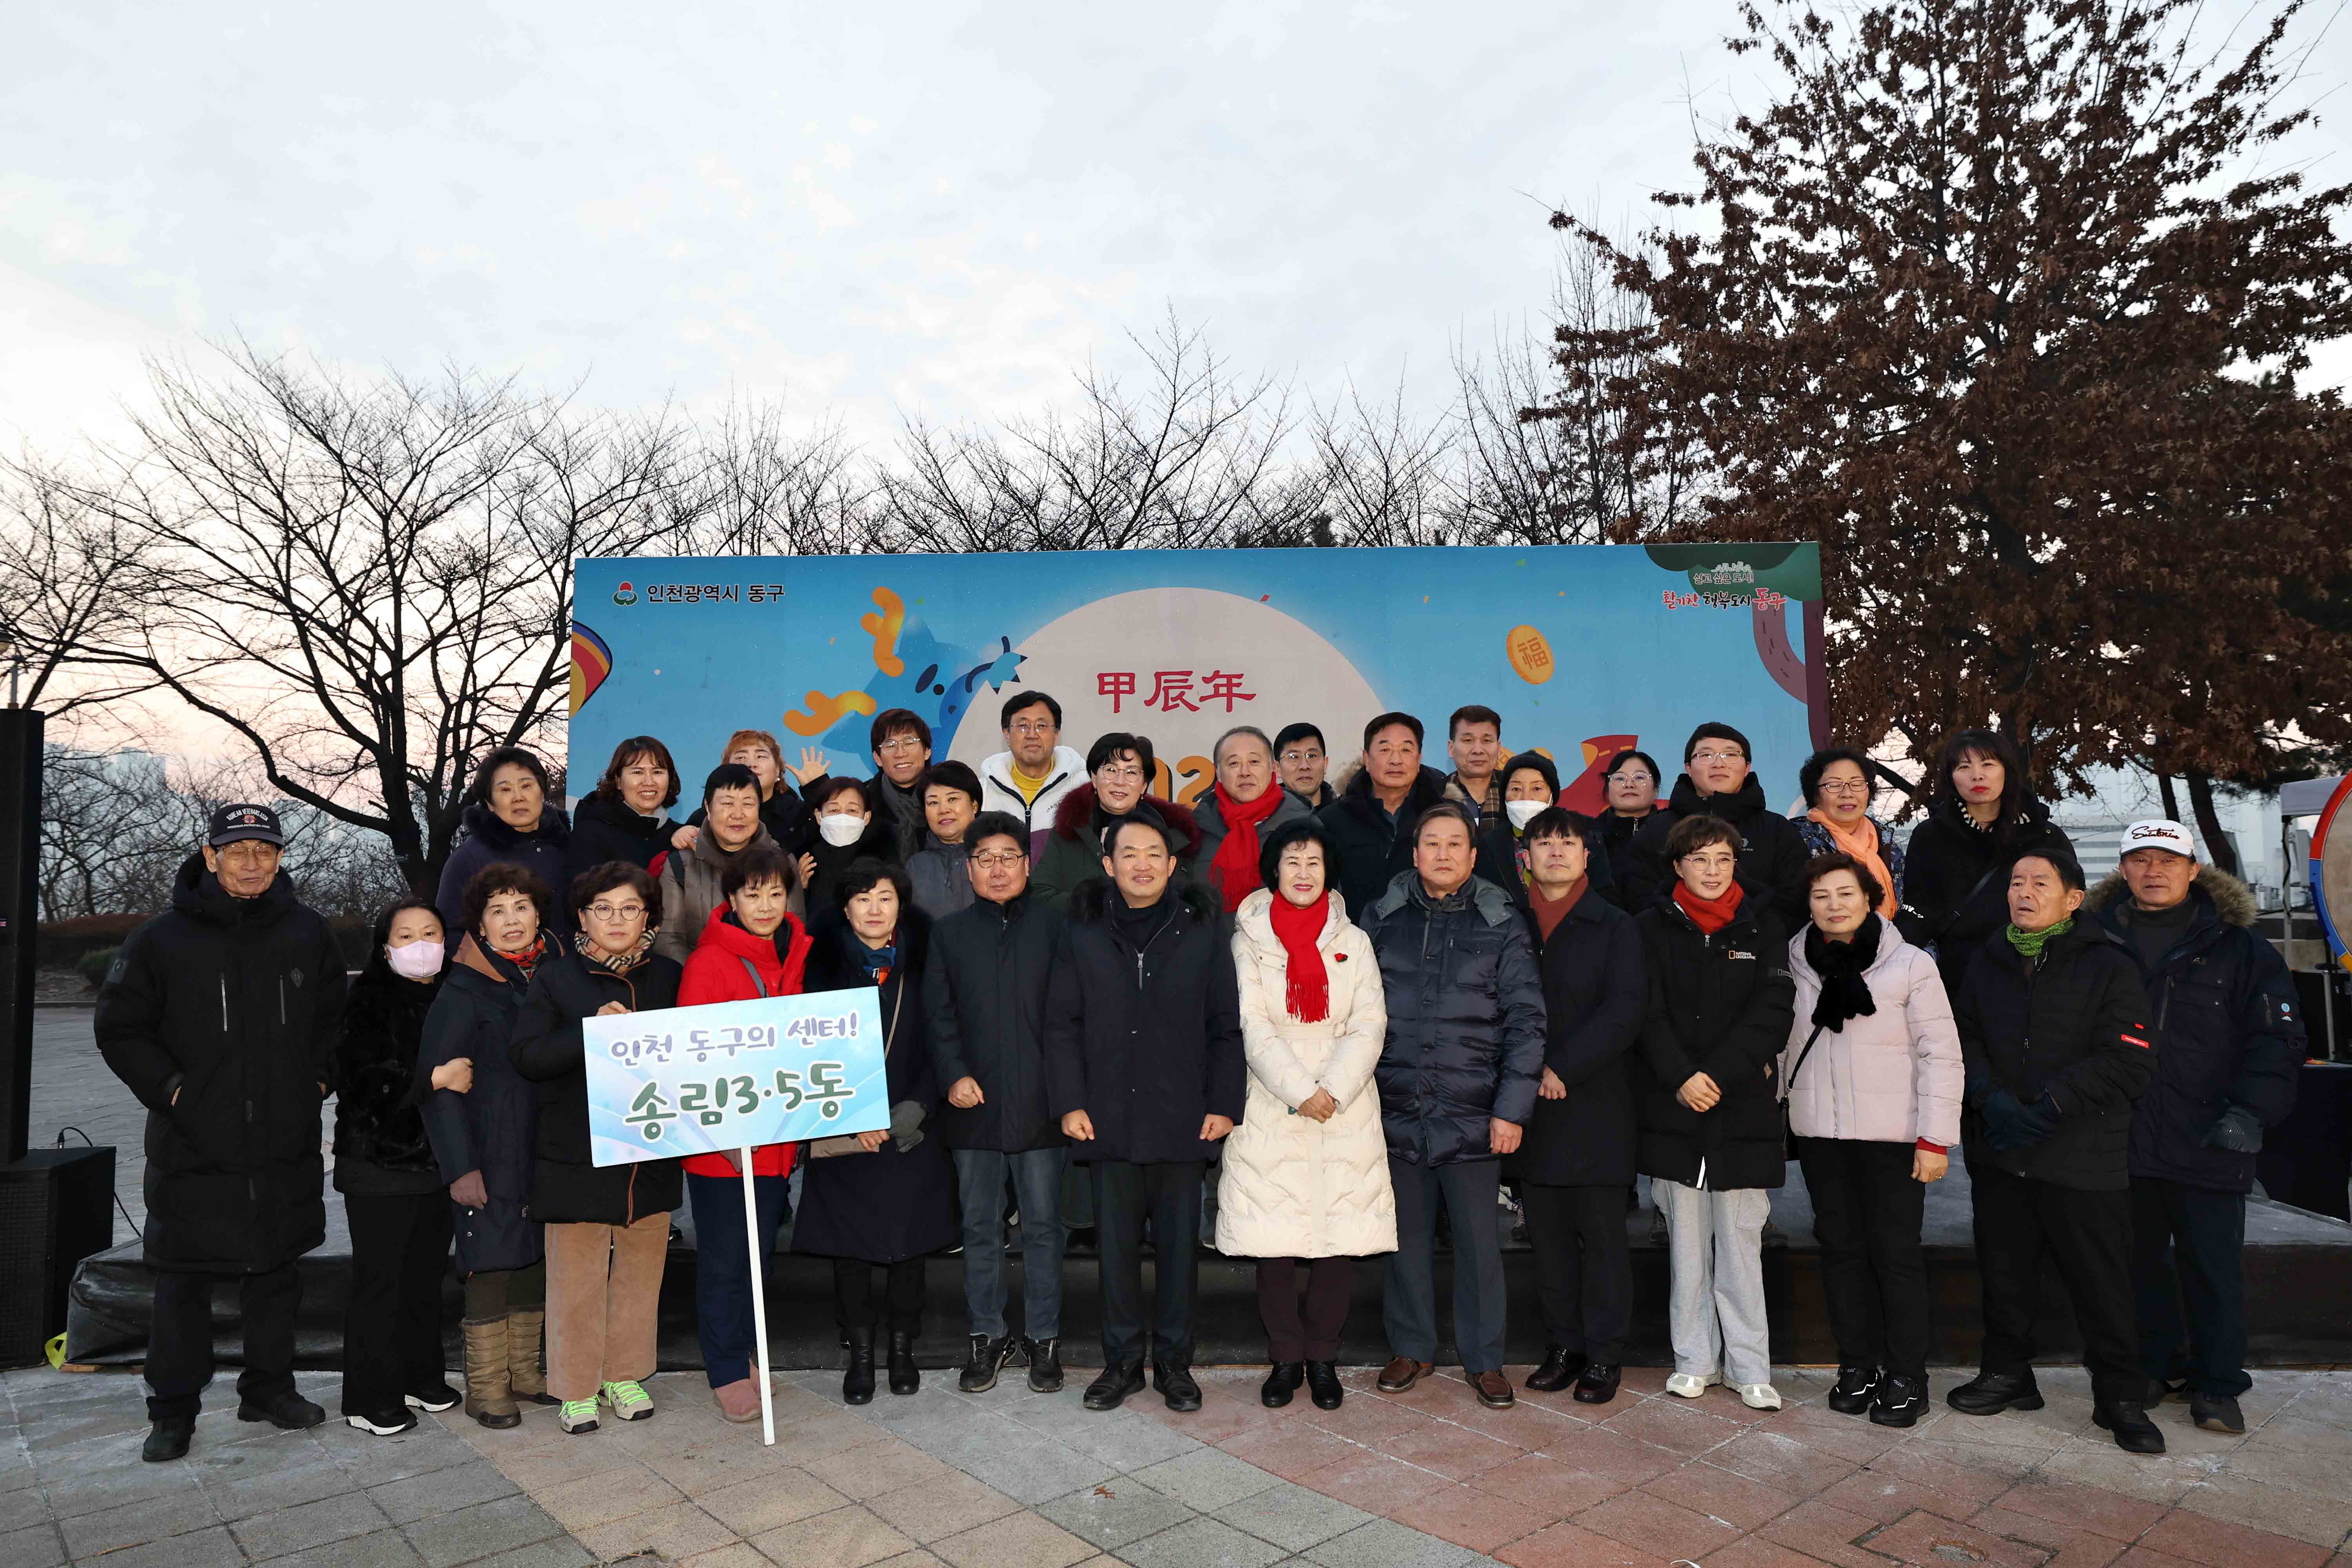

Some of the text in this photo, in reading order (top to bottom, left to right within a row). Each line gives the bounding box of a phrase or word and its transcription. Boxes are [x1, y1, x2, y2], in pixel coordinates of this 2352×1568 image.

[1693, 573, 1754, 584] 살고 싶은 도시!
[647, 584, 785, 603] 인천광역시 동구
[1662, 588, 1787, 611] 활기찬 행복도시 동구
[1517, 637, 1550, 670] 福
[1096, 669, 1257, 714] 甲辰年
[226, 809, 243, 821] KOREAN
[241, 808, 261, 817] VETERANS
[611, 1012, 858, 1066] 인천 동구의 센터!
